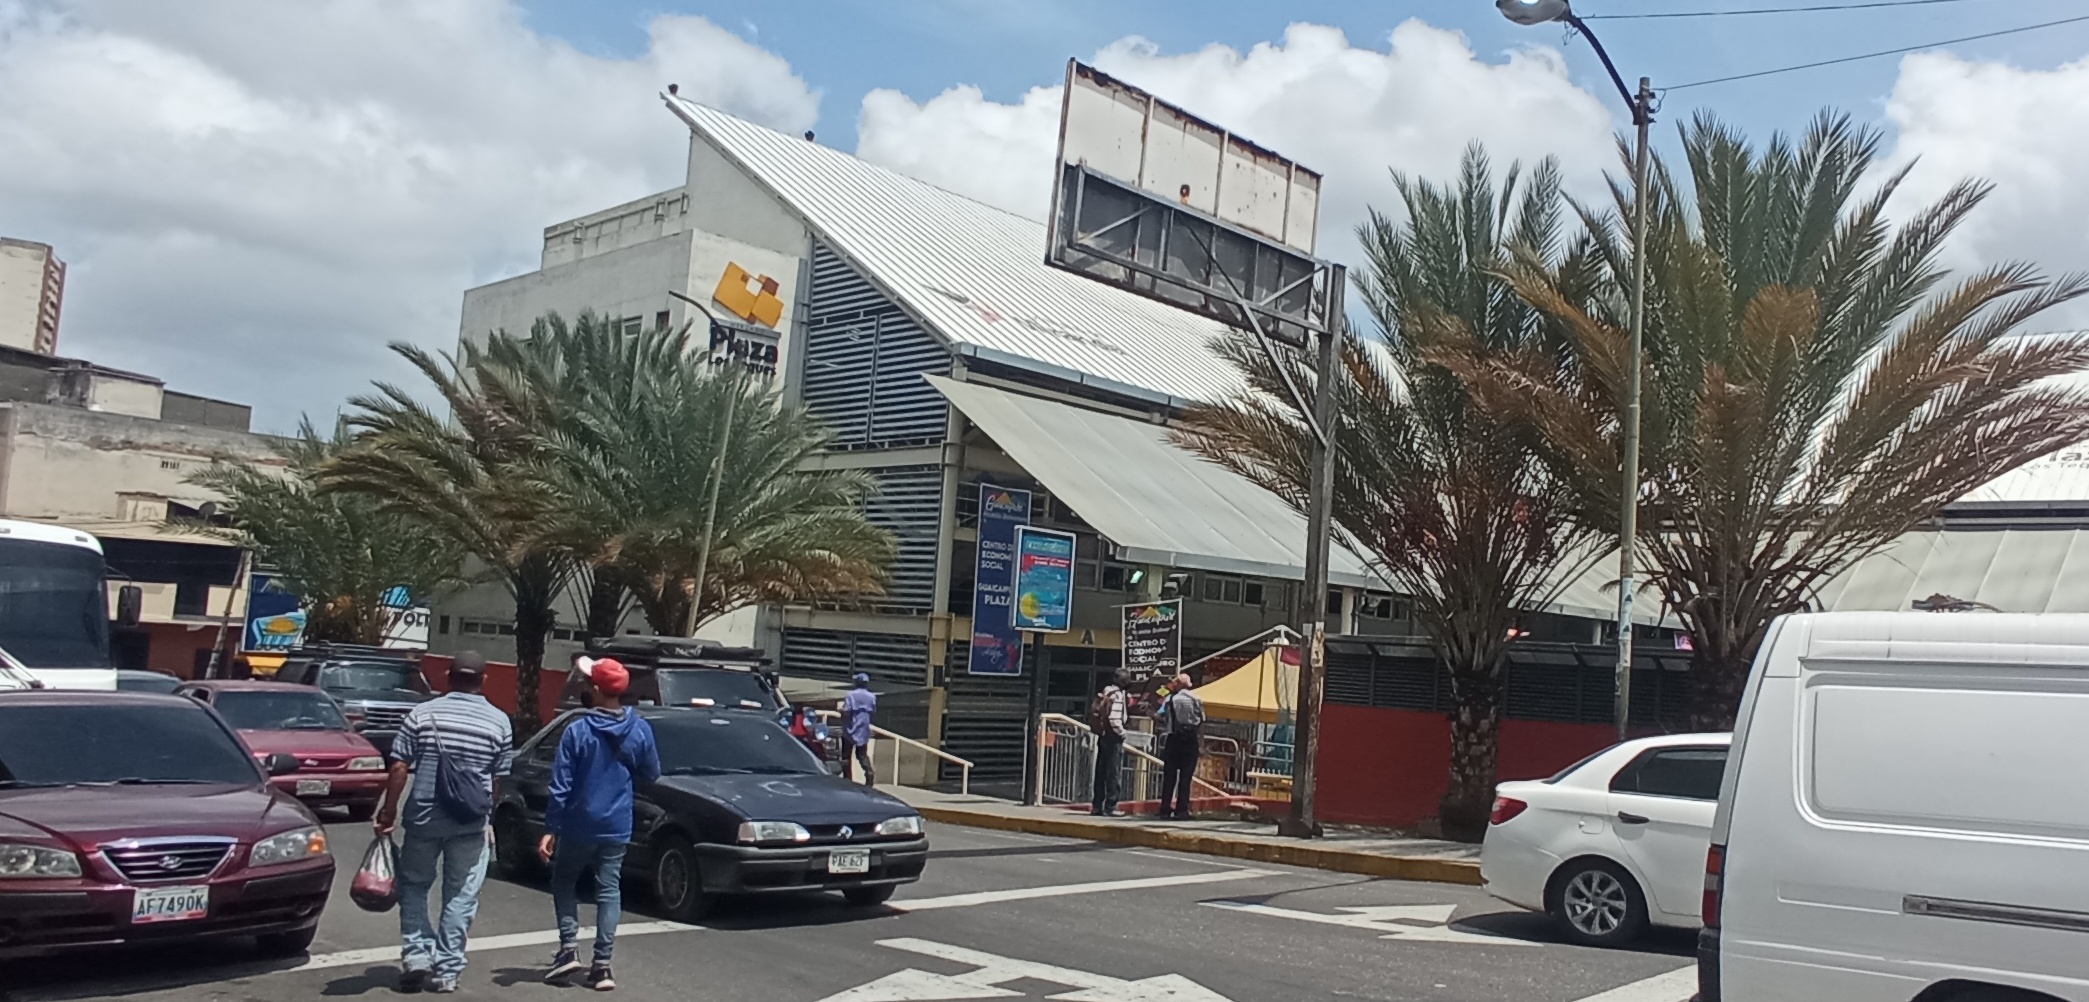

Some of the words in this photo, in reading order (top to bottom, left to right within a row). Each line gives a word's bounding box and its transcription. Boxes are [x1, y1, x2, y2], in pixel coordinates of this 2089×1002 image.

[981, 560, 1004, 570] SOCIAL
[1128, 639, 1158, 648] CENTRO
[1129, 655, 1157, 663] SOCIAL
